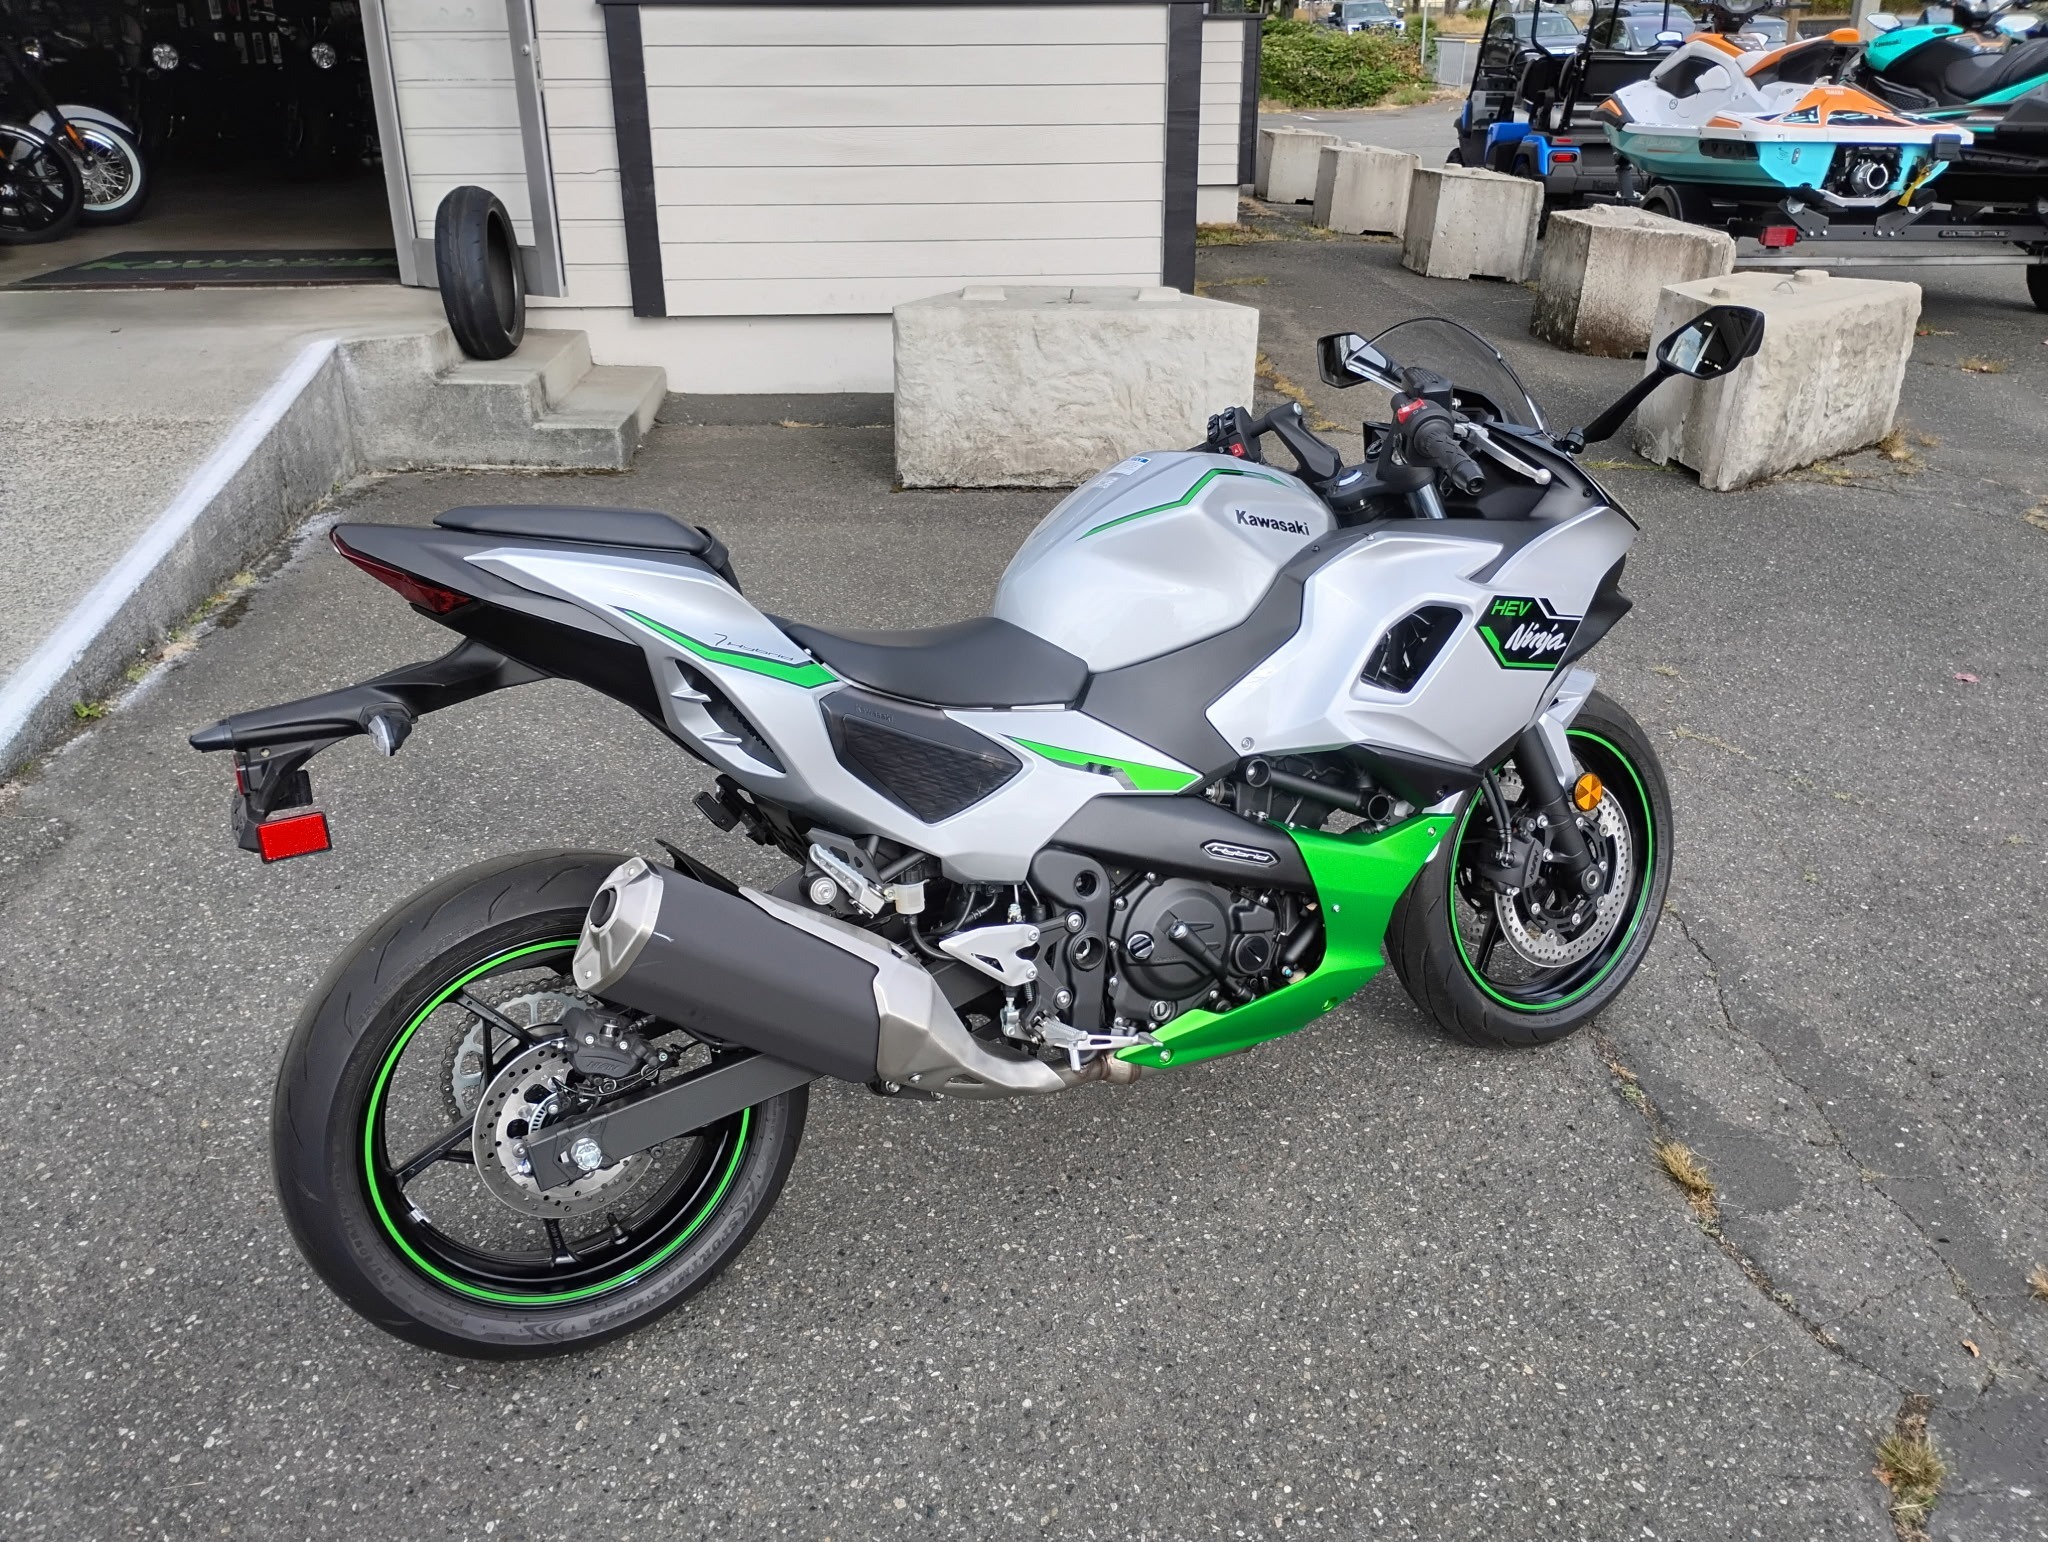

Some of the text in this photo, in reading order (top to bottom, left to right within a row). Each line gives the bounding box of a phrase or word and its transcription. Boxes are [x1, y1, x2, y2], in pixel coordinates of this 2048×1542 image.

[1235, 509, 1310, 536] Kawasaki
[1490, 599, 1533, 616] HEV
[1504, 621, 1567, 660] Ninja
[726, 641, 795, 662] Hybrid
[1211, 846, 1270, 861] Hybrid
